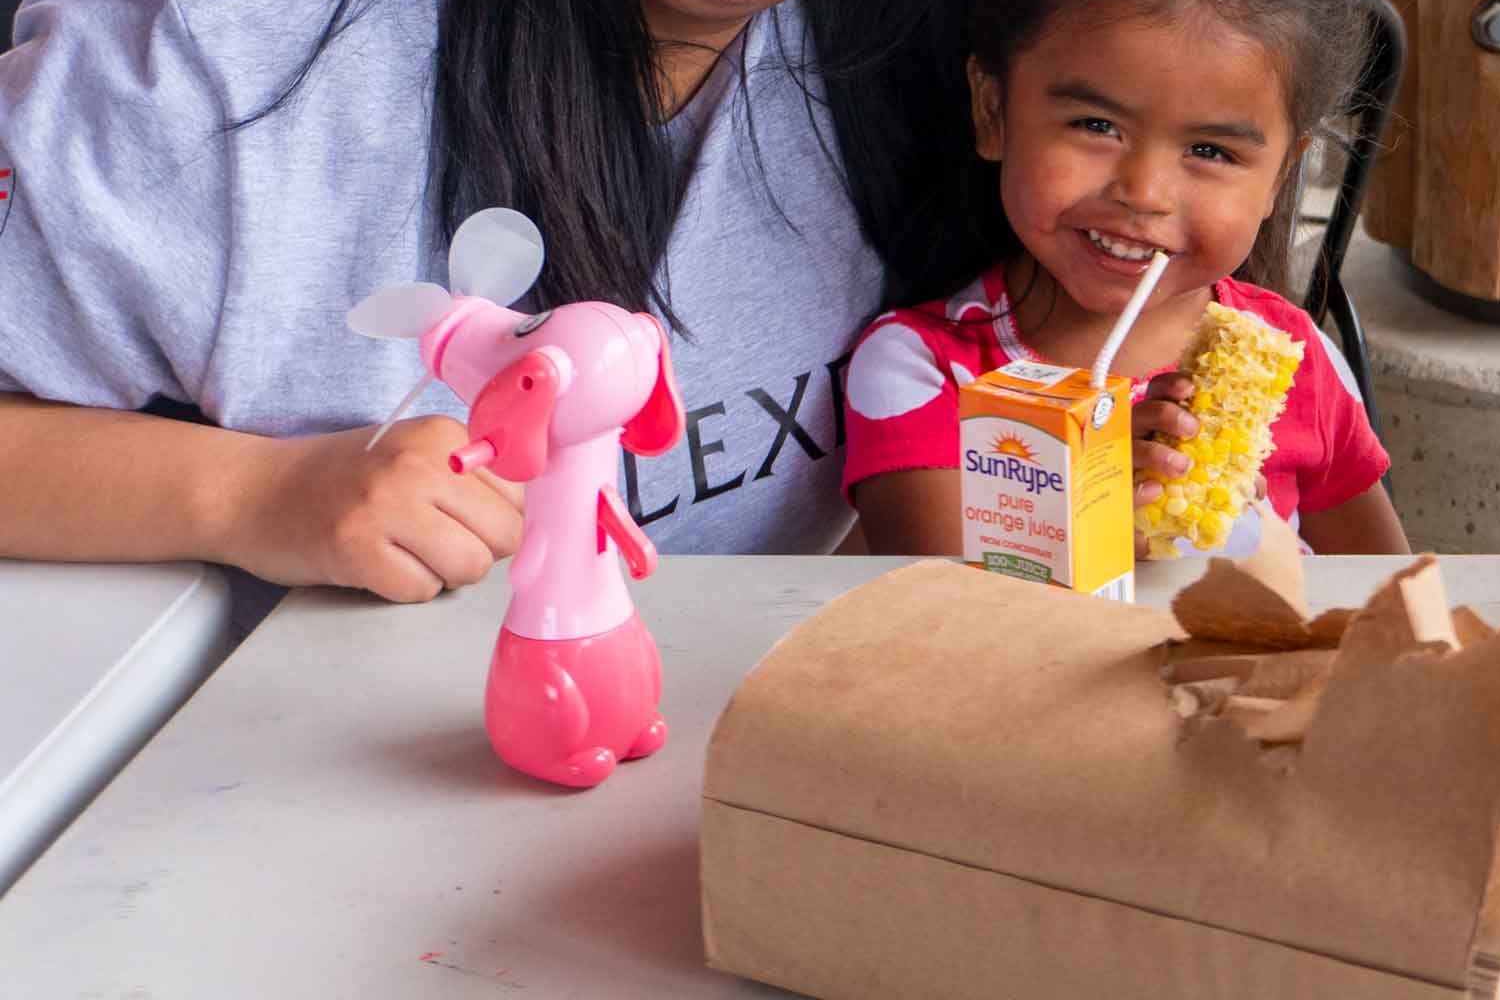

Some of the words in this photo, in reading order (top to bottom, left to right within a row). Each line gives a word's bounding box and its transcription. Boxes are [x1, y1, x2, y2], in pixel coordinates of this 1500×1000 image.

[965, 449, 1064, 495] SunRype
[998, 493, 1034, 514] pure
[966, 506, 1024, 532] orange
[1029, 516, 1065, 542] juice
